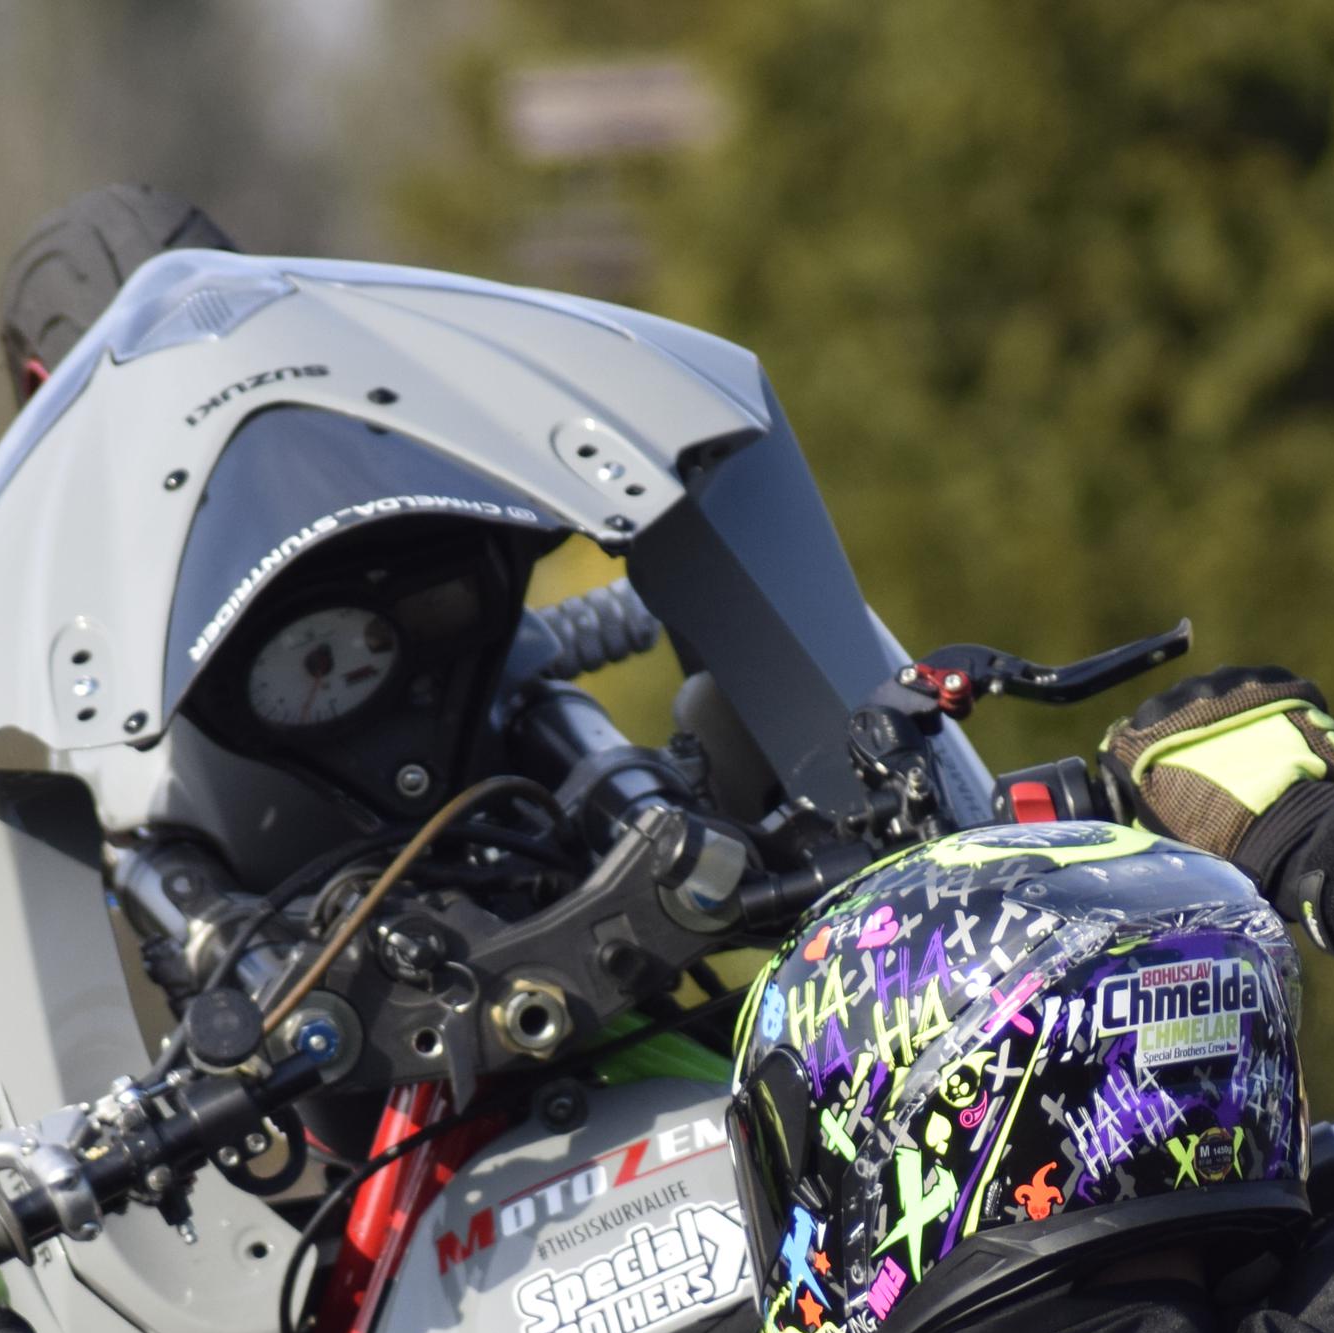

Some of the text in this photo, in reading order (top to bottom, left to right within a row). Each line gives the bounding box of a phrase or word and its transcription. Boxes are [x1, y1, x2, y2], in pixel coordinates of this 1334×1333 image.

[185, 364, 329, 427] SUZUKI
[1101, 962, 1259, 1030] Chmelda
[1141, 960, 1212, 988] BOHUSLAV
[1141, 1013, 1239, 1051] CHMELAR
[1143, 1041, 1226, 1064] Special Brothers Crew
[537, 1180, 691, 1261] #THISISKURVALIFE
